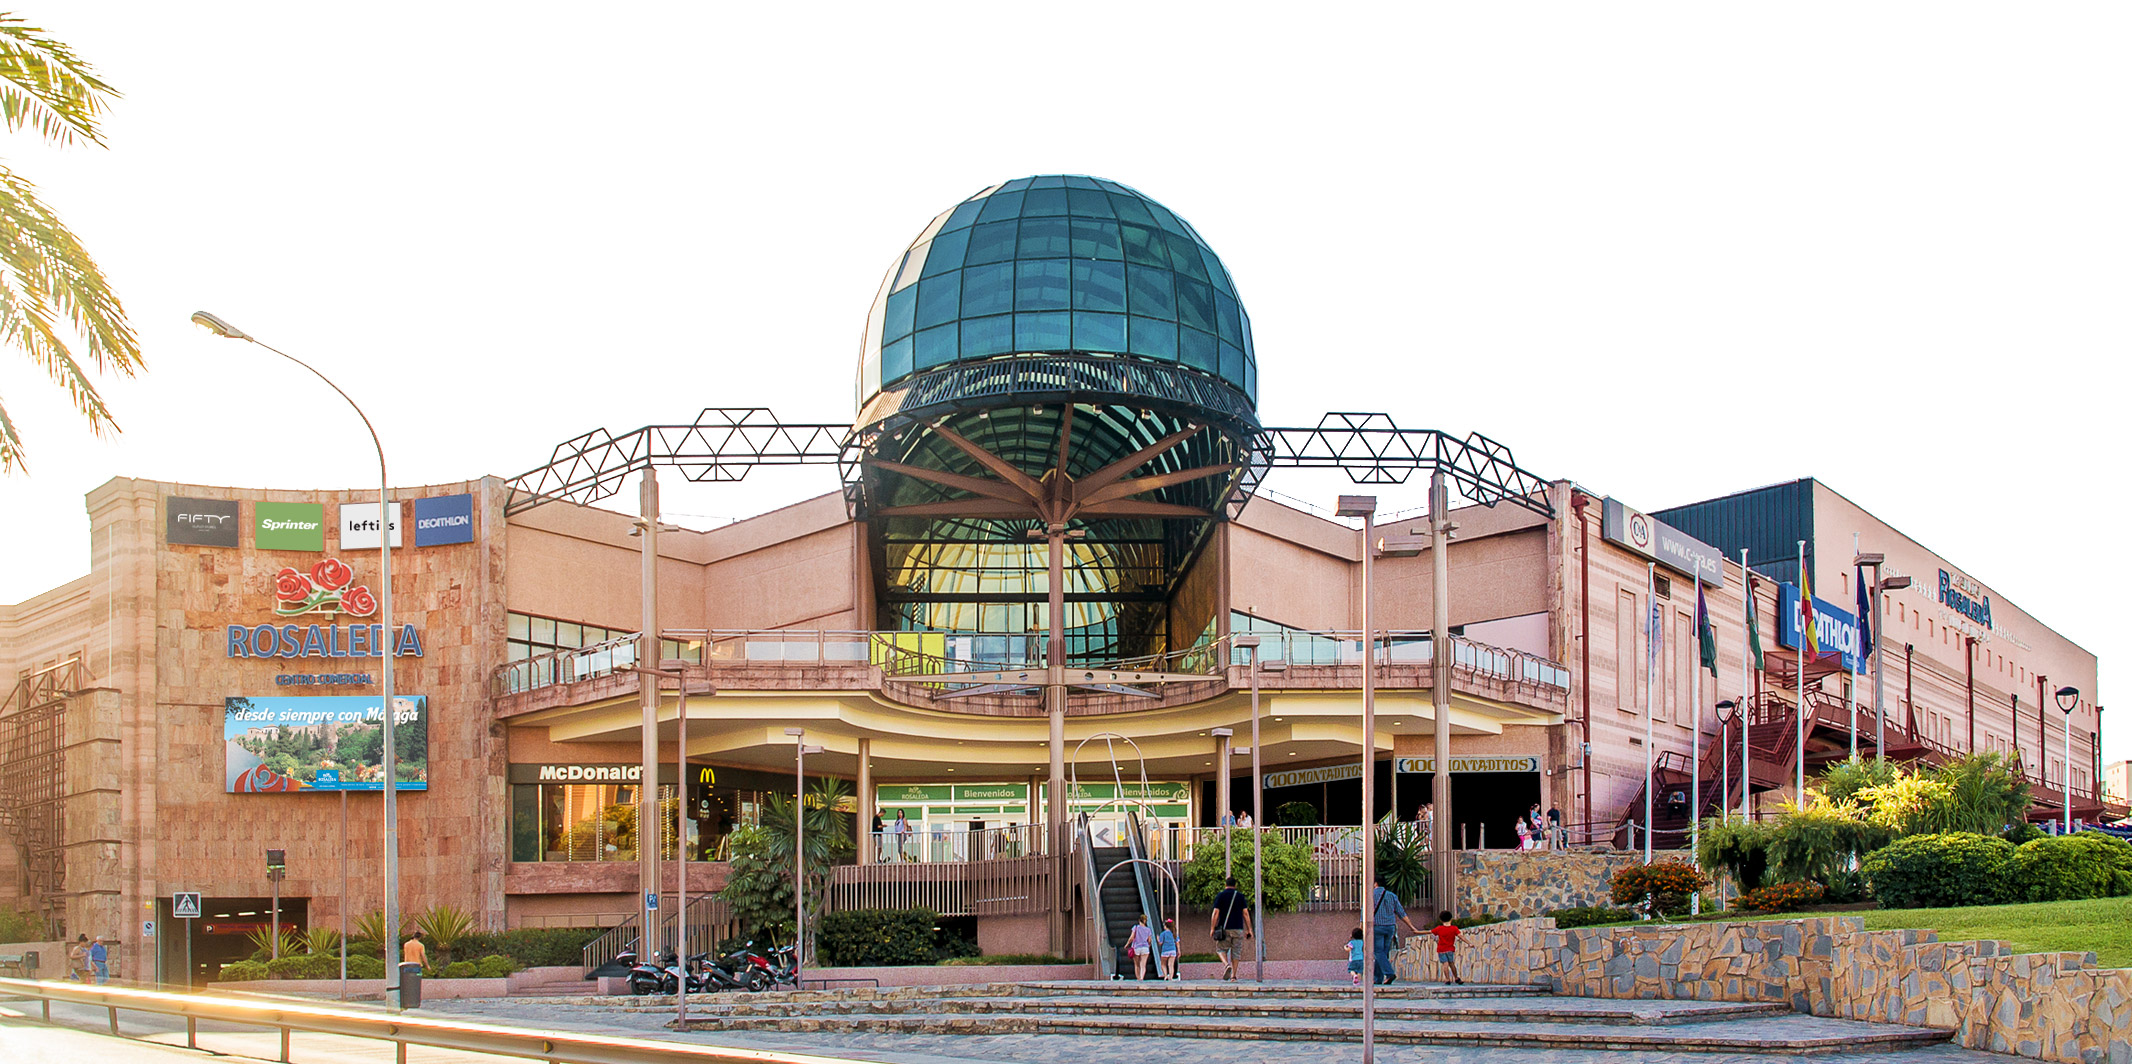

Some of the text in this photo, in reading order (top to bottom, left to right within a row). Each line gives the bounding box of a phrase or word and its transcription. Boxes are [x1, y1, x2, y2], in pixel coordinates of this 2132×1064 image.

[177, 513, 231, 524] FIFTY
[261, 518, 319, 532] Sprinter
[349, 519, 395, 531] leftis
[418, 515, 469, 530] DECATHLON
[1938, 568, 1992, 630] ROSALEDA
[275, 673, 374, 686] CENTRO COMERCIAL
[234, 706, 419, 725] desde siempre con Máaga
[964, 788, 1015, 798] Bienvenidos
